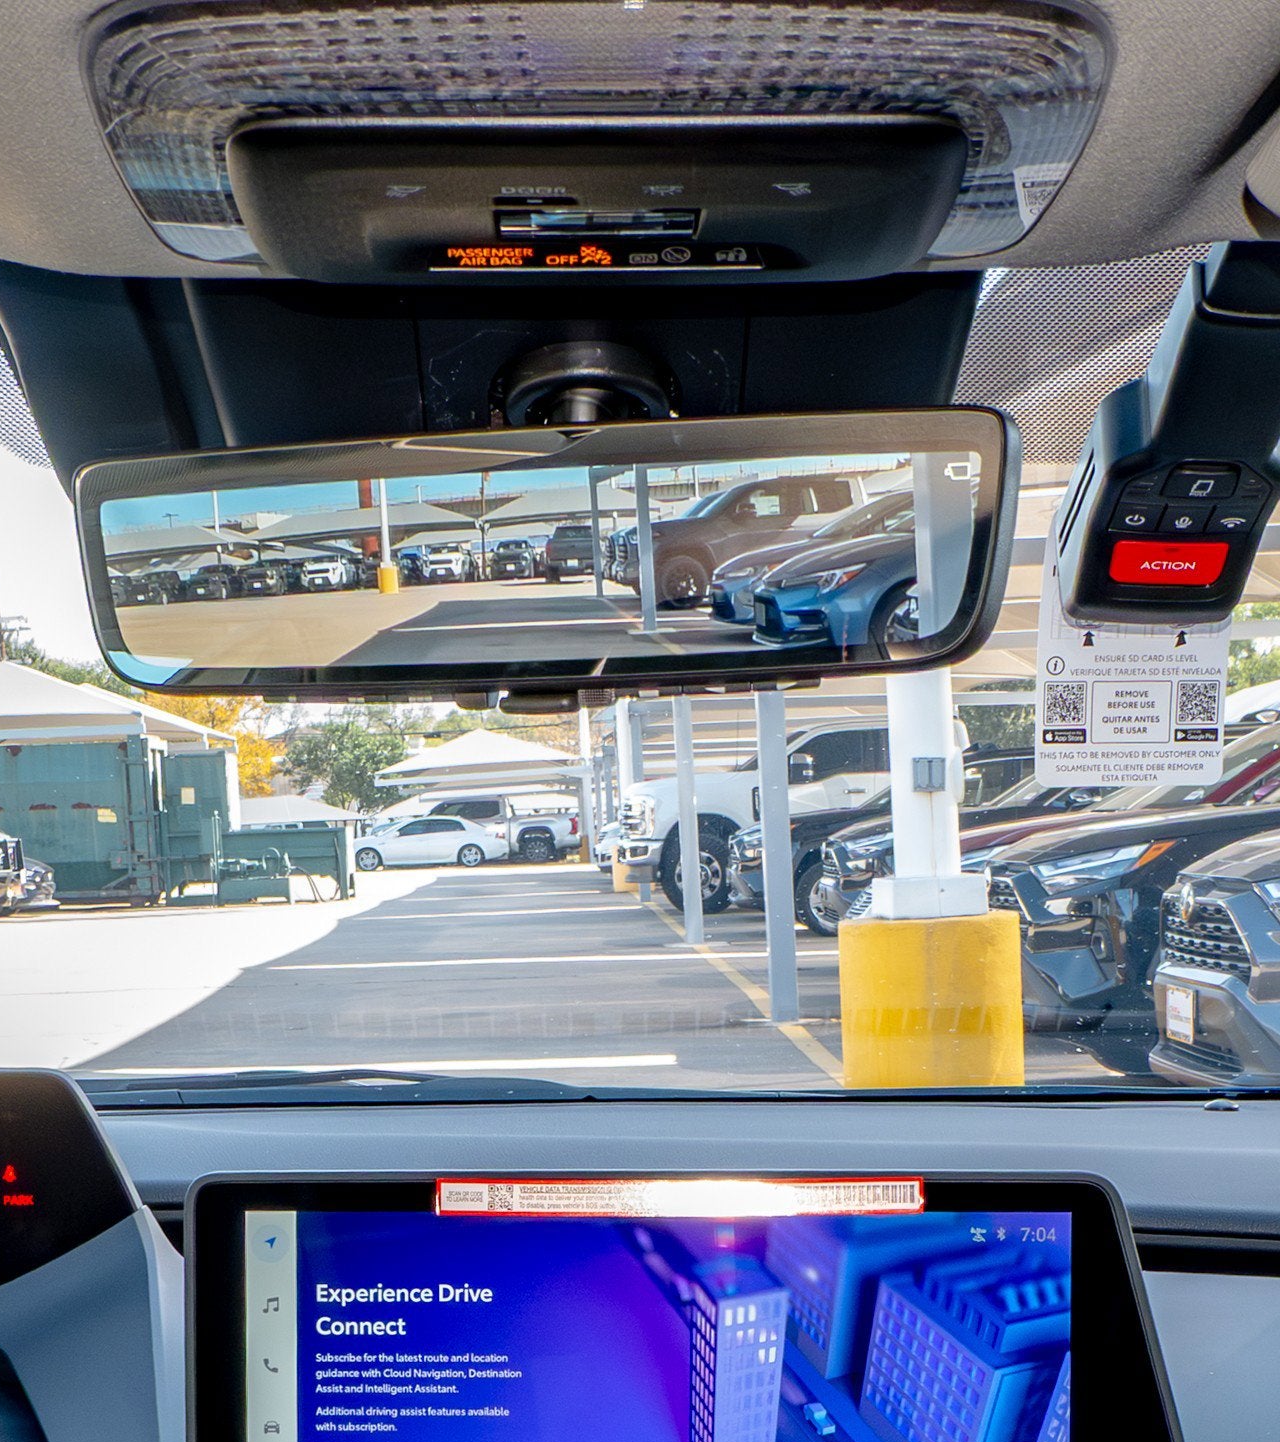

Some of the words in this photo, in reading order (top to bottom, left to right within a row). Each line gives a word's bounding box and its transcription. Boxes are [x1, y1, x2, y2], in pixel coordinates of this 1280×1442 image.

[447, 247, 535, 258] PASSENGER
[545, 255, 579, 266] OFF
[459, 256, 488, 266] AIR
[490, 255, 524, 267] BAG
[1140, 561, 1196, 570] ACTION
[1094, 654, 1126, 663] ENSURE
[1128, 654, 1139, 662] SD
[1141, 654, 1165, 662] CARD
[1166, 654, 1173, 662] IS
[1175, 654, 1198, 662] LEVEL
[1070, 668, 1112, 677] VERIFIQUE
[1114, 668, 1147, 677] TARJETA
[1149, 668, 1160, 676] SD
[1114, 690, 1150, 698] REMOVE
[1107, 701, 1138, 709] BEFORE
[1140, 701, 1156, 709] USE
[1102, 715, 1133, 724] QUITAR
[1134, 715, 1160, 723] ANTES
[1113, 727, 1124, 735] DE
[1040, 752, 1058, 760] THIS
[1059, 752, 1075, 760] TAG
[1101, 752, 1140, 760] REMOVED
[1141, 751, 1151, 759] BY
[1153, 751, 1197, 759] CUSTOMER
[1199, 751, 1221, 759] ONLY
[1055, 764, 1101, 772] SOLAMENTE
[1103, 764, 1112, 772] EL
[1113, 764, 1144, 772] CLIENTE
[1167, 763, 1204, 771] REMOVER
[1101, 774, 1120, 782] ESTA
[1121, 774, 1158, 782] ETIQUETA
[3, 1194, 35, 1206] PARK
[1020, 1227, 1057, 1243] 7:04
[315, 1283, 433, 1307] Experience
[438, 1283, 493, 1302] Drive
[315, 1316, 407, 1336] Connect
[315, 1353, 362, 1363] Subscribe
[363, 1353, 377, 1363] for
[378, 1353, 394, 1363] the
[395, 1353, 422, 1363] latest
[424, 1354, 449, 1363] route
[450, 1353, 469, 1363] and
[470, 1353, 509, 1363] location
[315, 1369, 360, 1380] guidance
[361, 1369, 381, 1378] with
[383, 1369, 412, 1378] Cloud
[413, 1369, 467, 1380] Navigation,
[468, 1369, 522, 1378] Destination
[315, 1384, 344, 1394] Assist
[344, 1384, 364, 1394] and
[365, 1384, 412, 1396] Intelligent
[414, 1384, 459, 1394] Assistant.
[315, 1407, 364, 1417] Additional
[365, 1407, 398, 1418] driving
[399, 1407, 426, 1417] assist
[427, 1407, 466, 1417] features
[467, 1407, 510, 1417] available
[315, 1423, 336, 1432] with
[337, 1423, 398, 1433] subscription.
